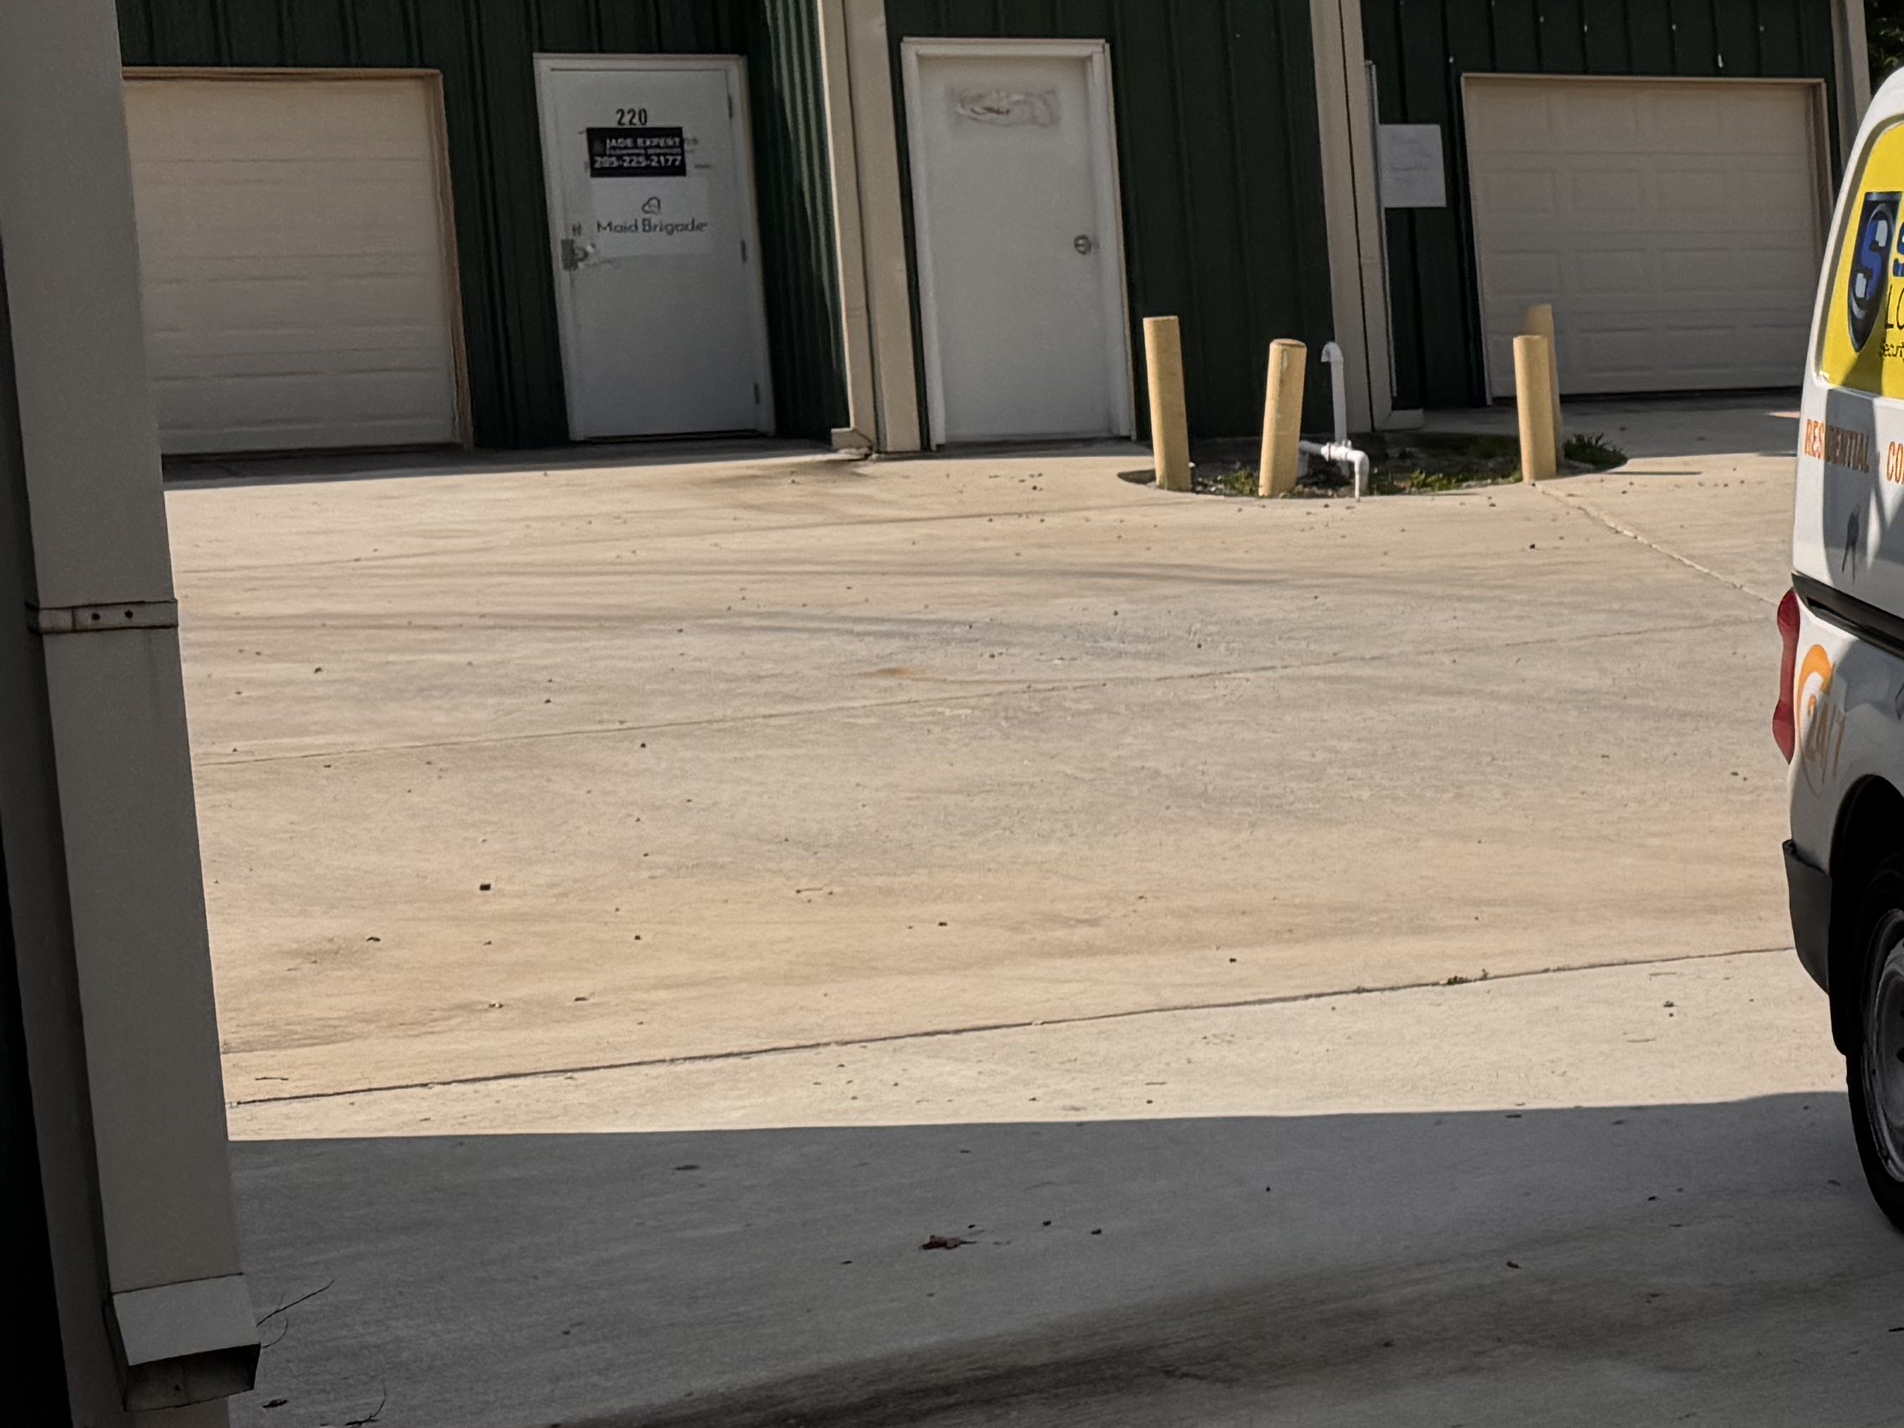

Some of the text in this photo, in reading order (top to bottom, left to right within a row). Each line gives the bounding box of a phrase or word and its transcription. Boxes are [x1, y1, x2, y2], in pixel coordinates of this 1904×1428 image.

[616, 108, 648, 126] 220
[596, 217, 708, 236] Maid Brigade
[1804, 419, 1870, 474] RESIDENTIAL
